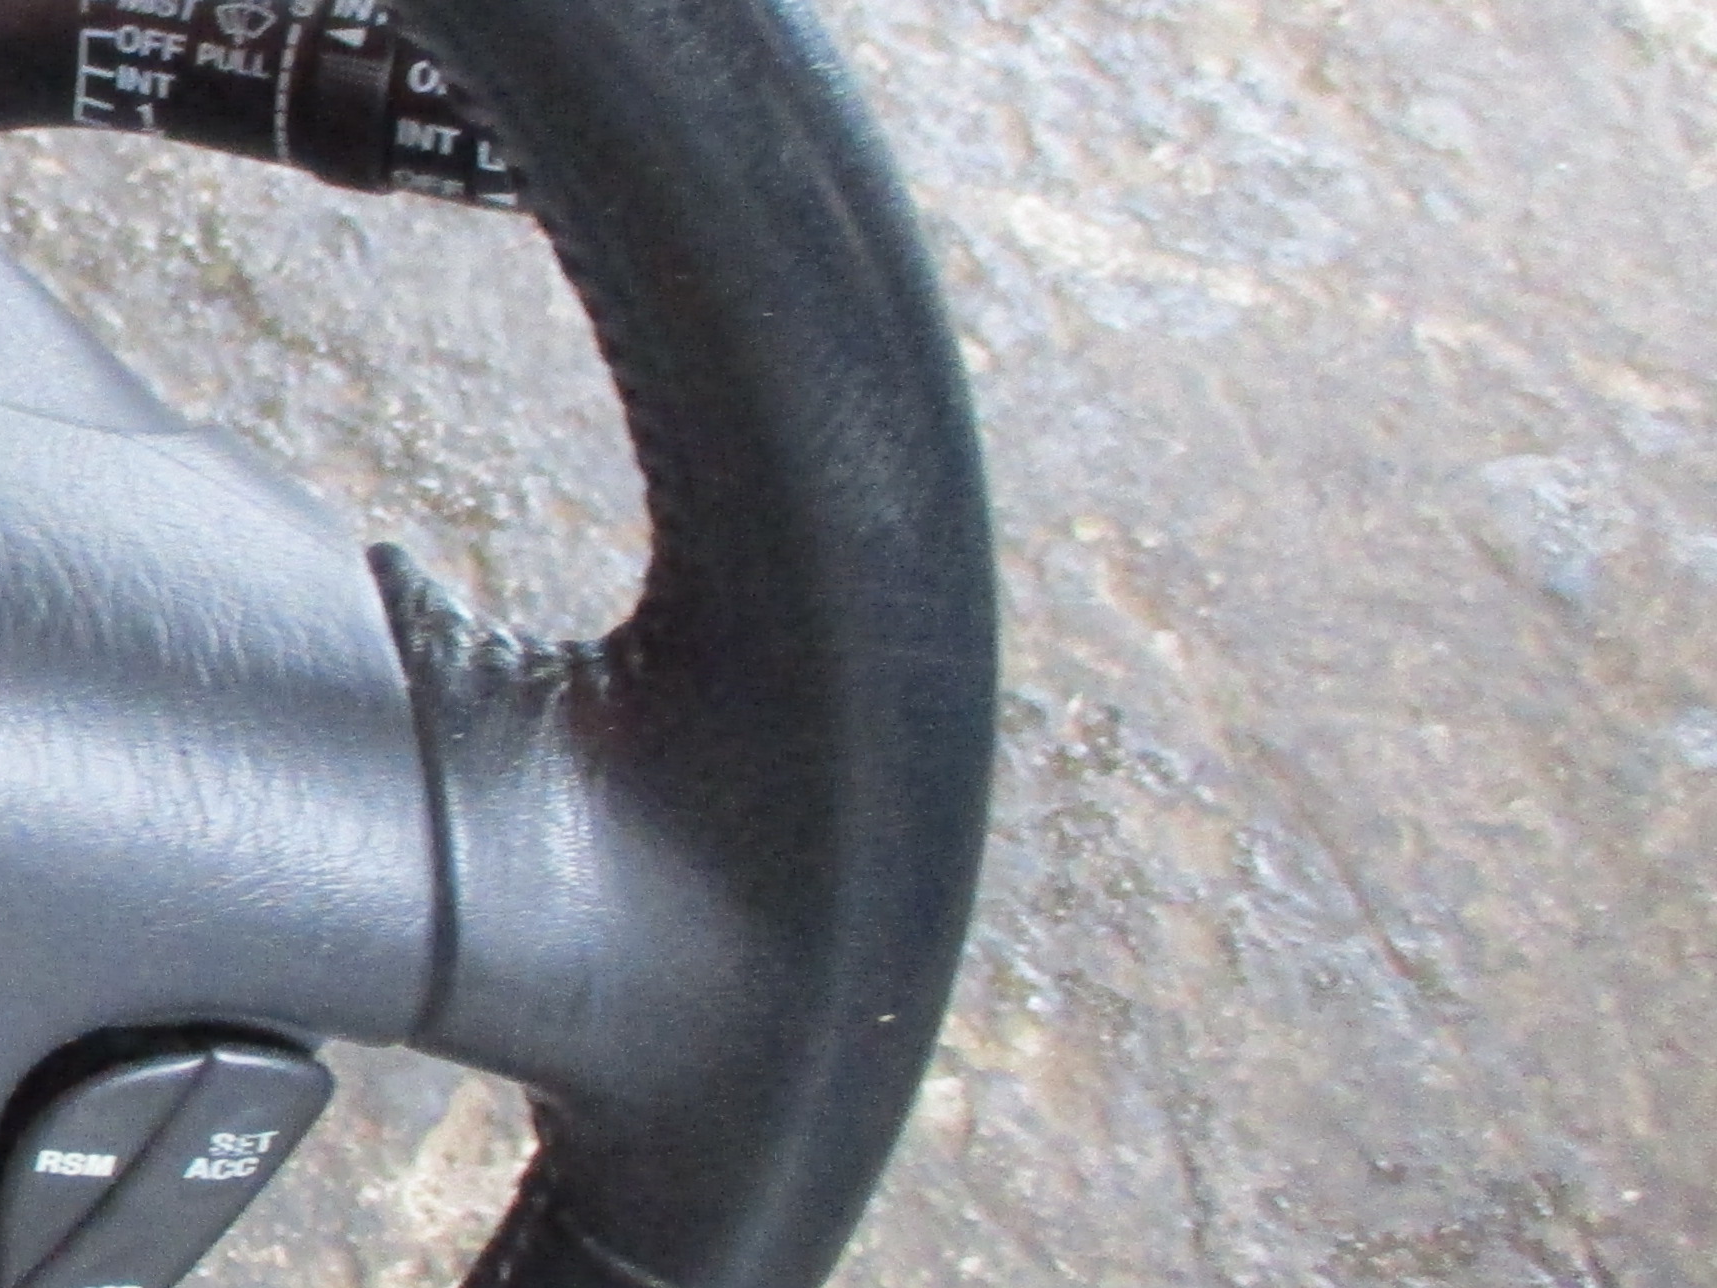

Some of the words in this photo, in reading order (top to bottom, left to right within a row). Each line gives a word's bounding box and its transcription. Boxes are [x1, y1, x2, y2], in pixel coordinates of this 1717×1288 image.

[116, 25, 188, 61] OFF
[195, 42, 270, 79] PULL
[116, 65, 176, 99] INT
[395, 117, 463, 155] INT
[208, 1130, 280, 1157] SET
[34, 1149, 118, 1177] RSM
[182, 1156, 260, 1180] ACC
